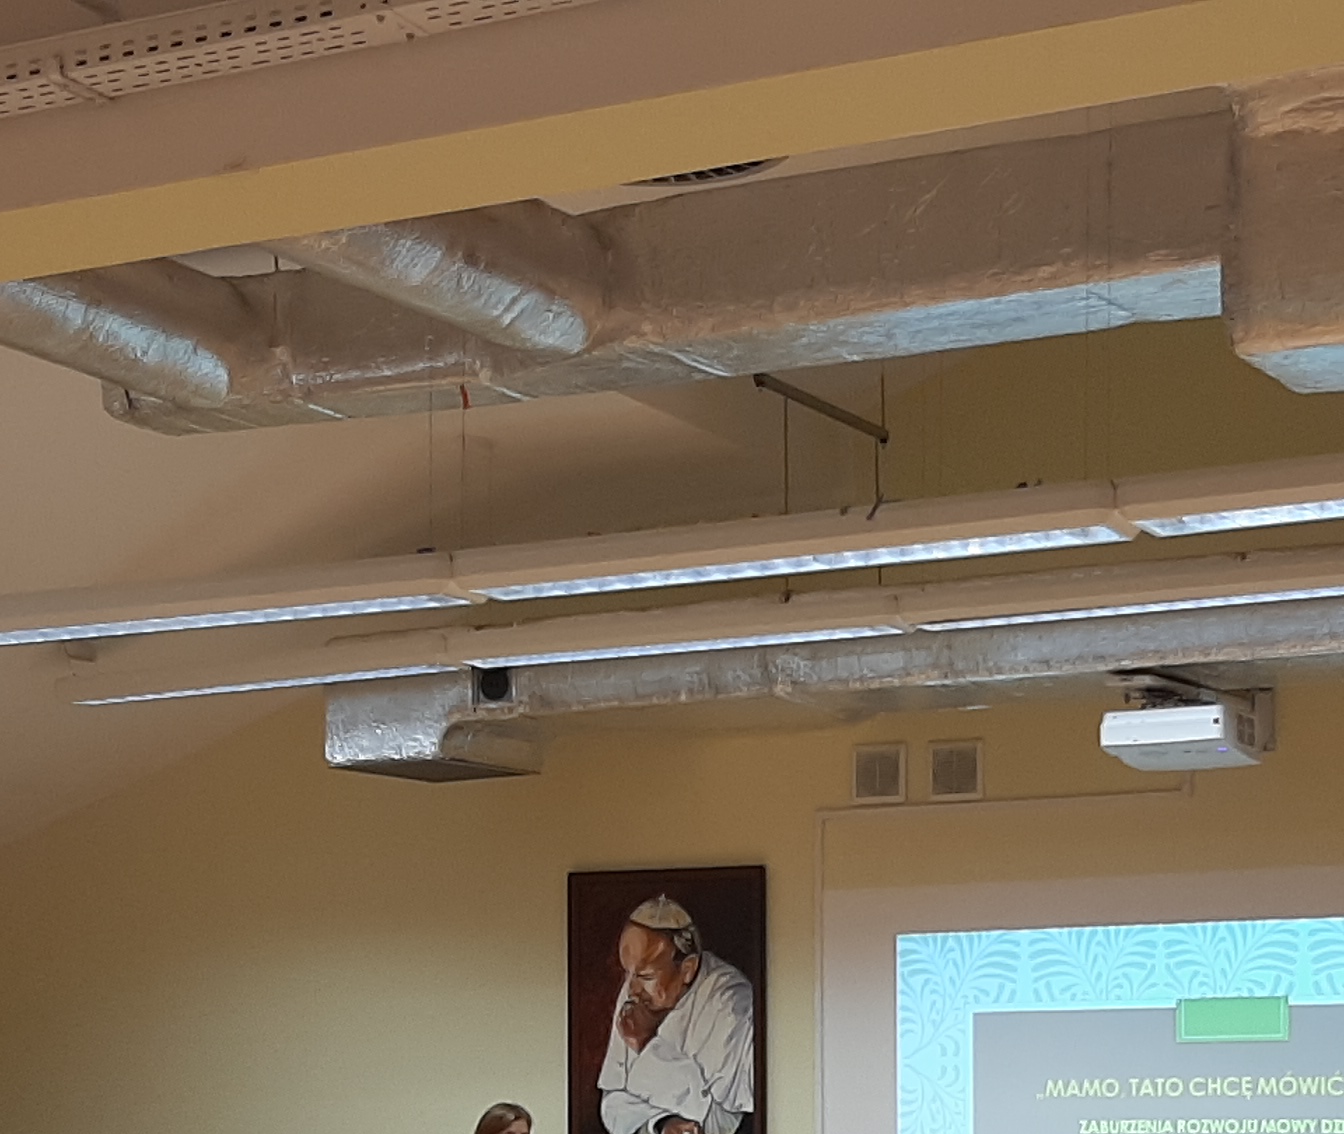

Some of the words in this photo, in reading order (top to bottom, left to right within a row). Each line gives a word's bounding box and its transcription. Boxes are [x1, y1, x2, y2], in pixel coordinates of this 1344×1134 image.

[1129, 1077, 1183, 1097] TATO
[1189, 1076, 1252, 1100] CHCĘ
[1257, 1071, 1344, 1096] MÓWIĆ
[1079, 1119, 1174, 1134] ZABURZENIA
[1177, 1119, 1258, 1134] ROZWOJU
[1260, 1119, 1316, 1134] MOWY
